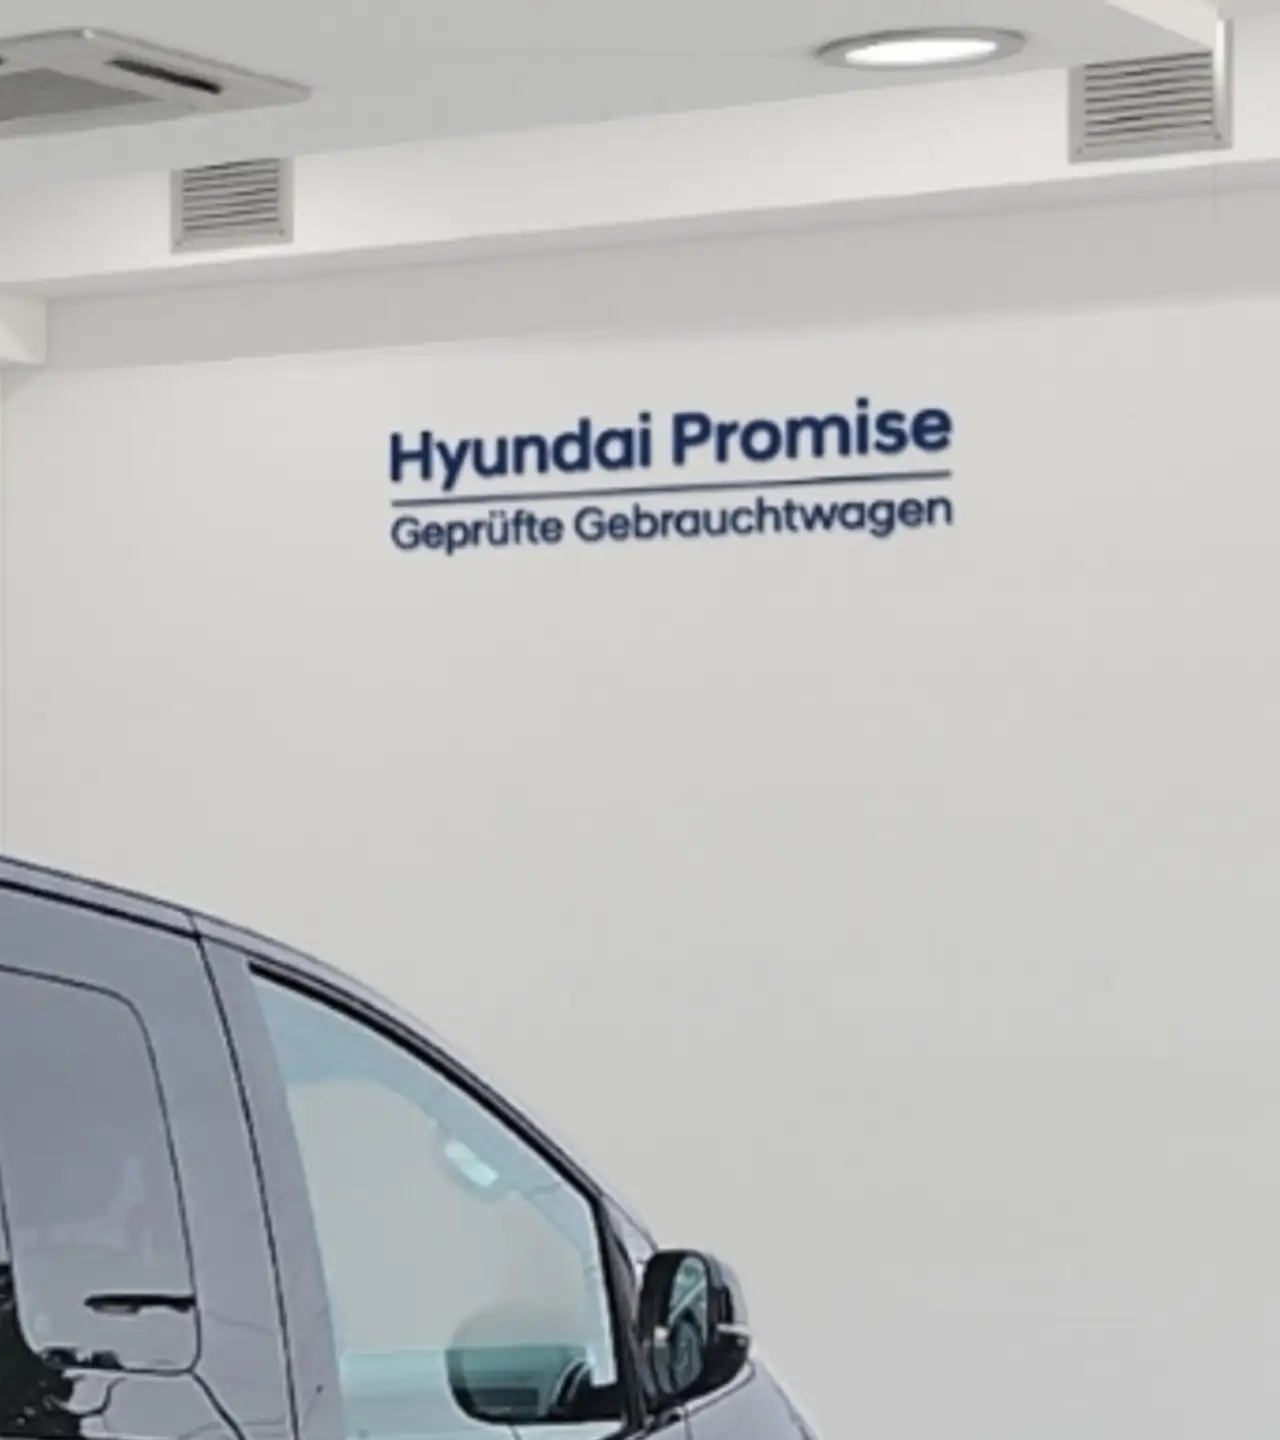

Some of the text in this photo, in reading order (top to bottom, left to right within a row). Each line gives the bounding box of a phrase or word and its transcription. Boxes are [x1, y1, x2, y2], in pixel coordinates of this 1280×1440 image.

[389, 396, 953, 493] Hyundai Promise
[390, 494, 953, 557] Geprüfte Gebrauchtwagen
